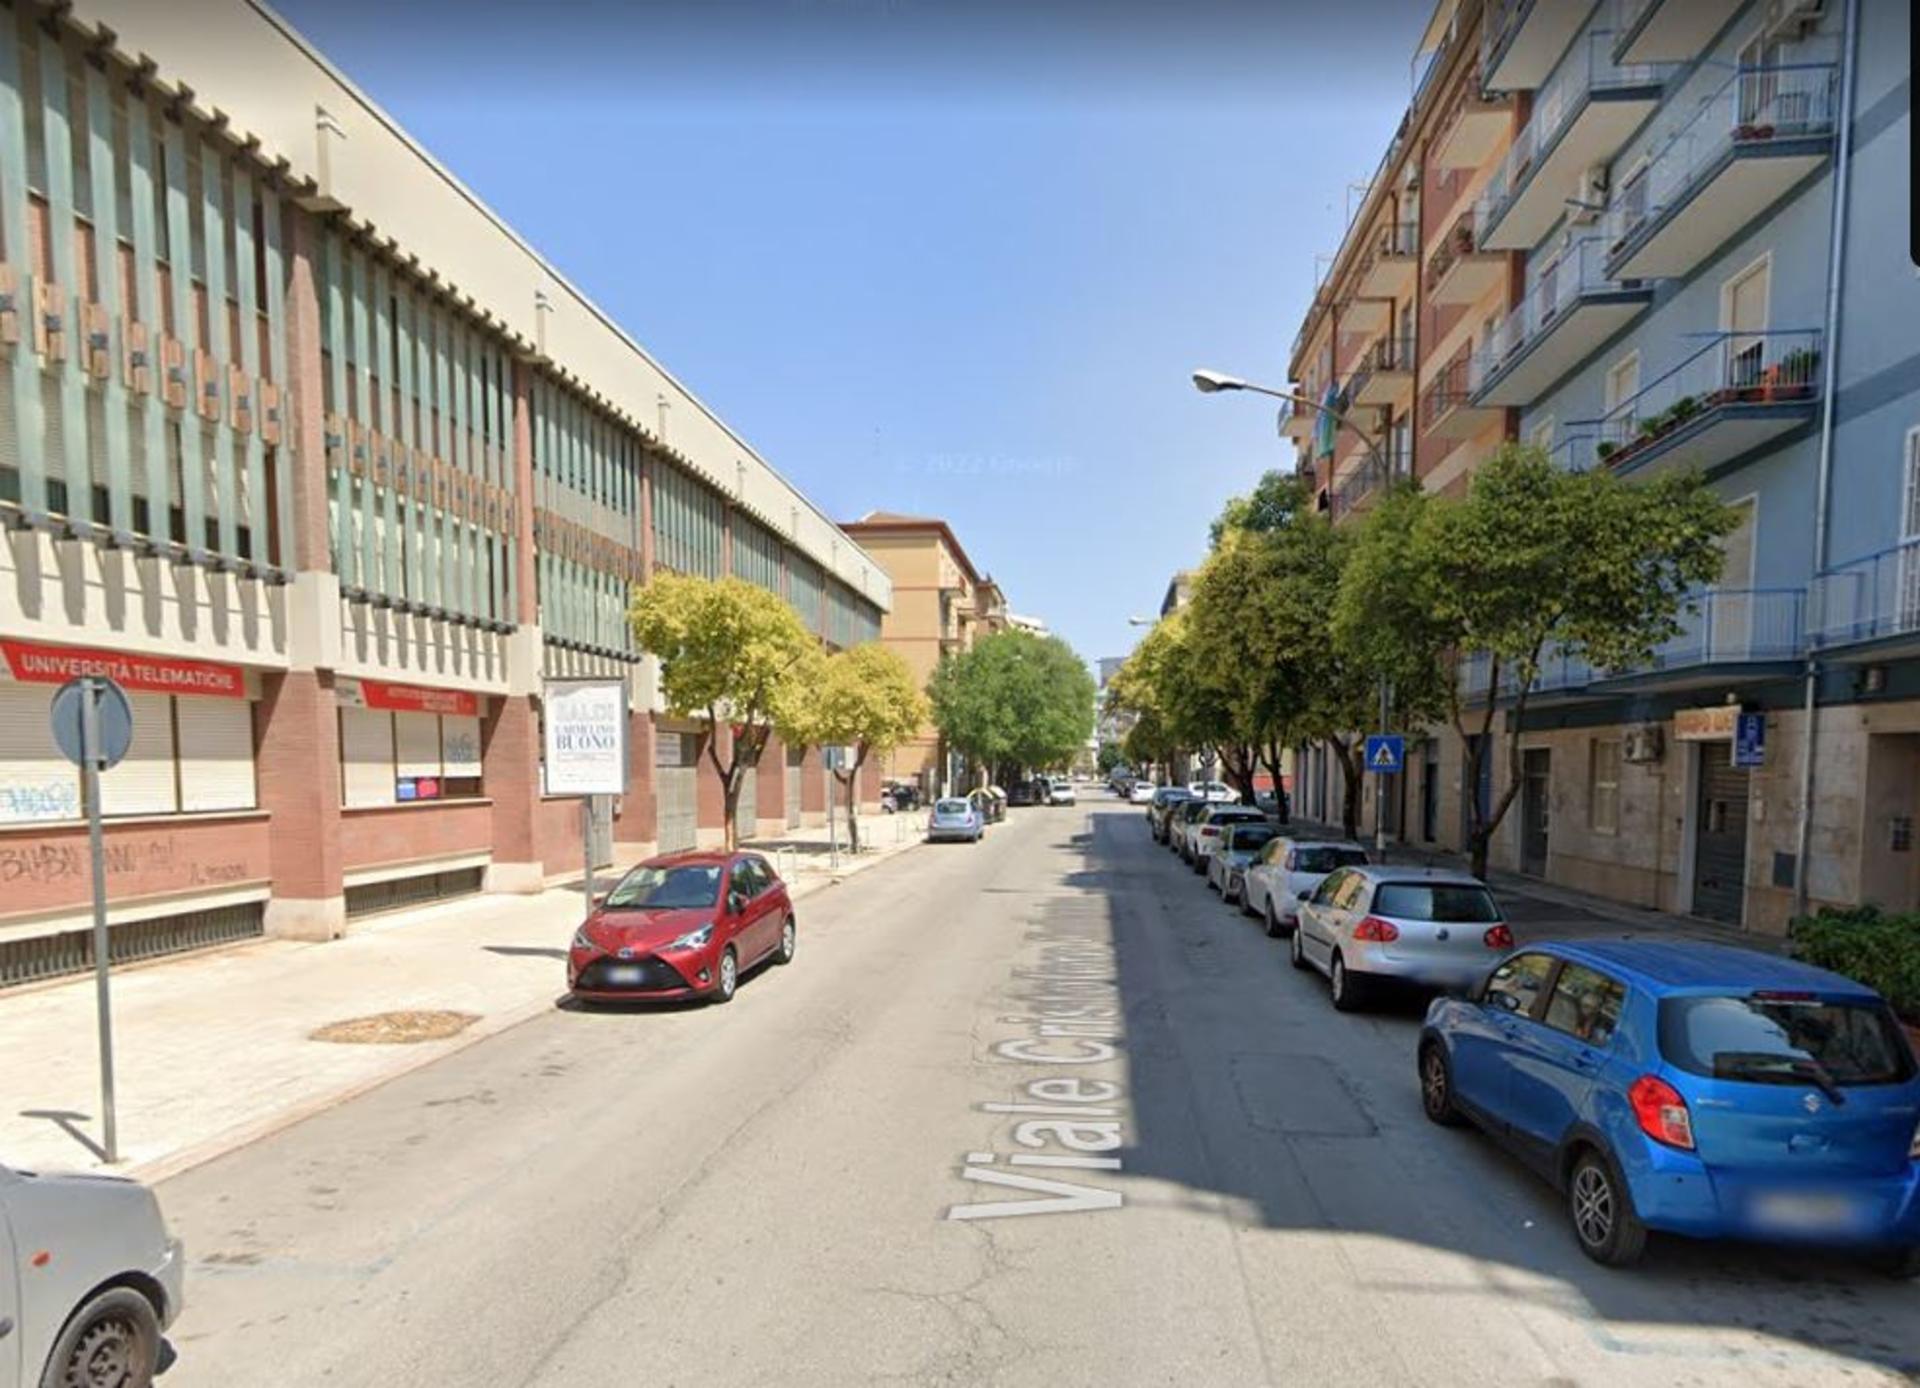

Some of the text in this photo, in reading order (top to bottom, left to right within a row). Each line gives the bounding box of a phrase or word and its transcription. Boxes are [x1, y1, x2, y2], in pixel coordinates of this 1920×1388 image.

[20, 653, 234, 688] UNIVERSITÀ TELEMATICHE
[556, 734, 615, 750] BUONO
